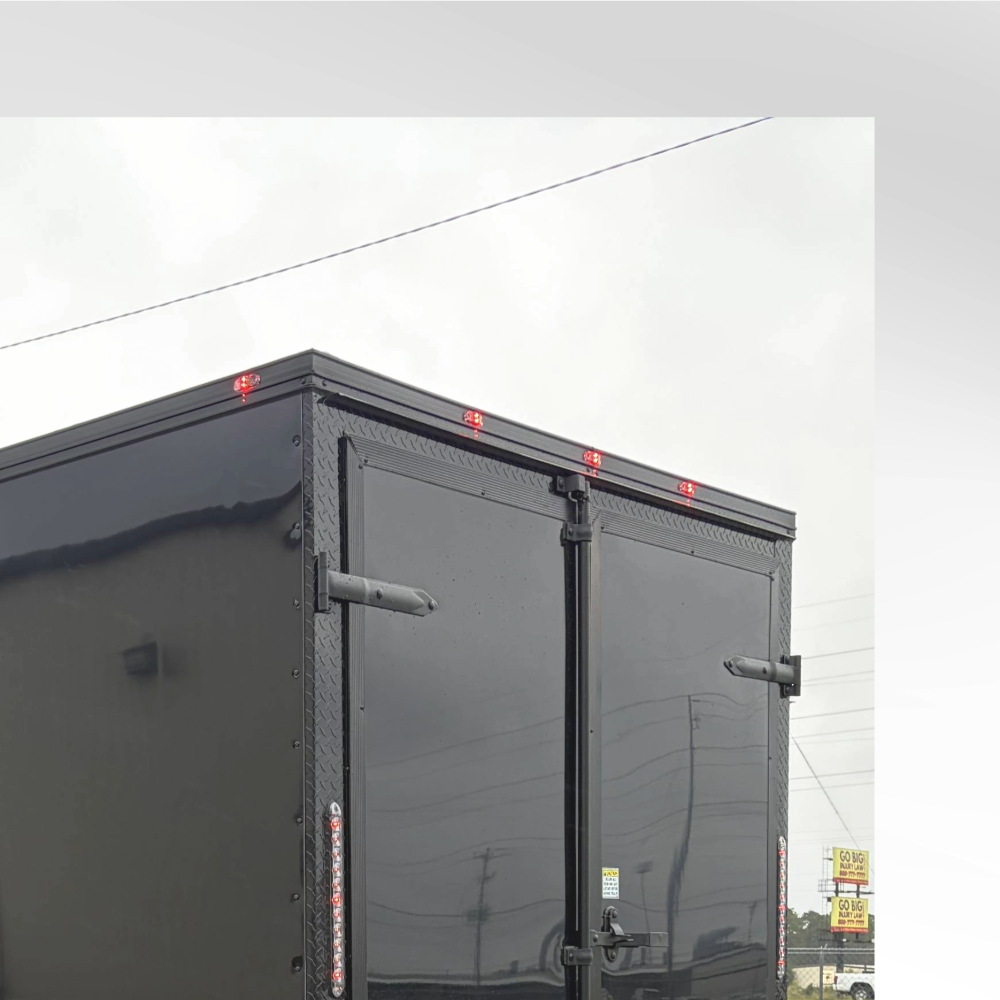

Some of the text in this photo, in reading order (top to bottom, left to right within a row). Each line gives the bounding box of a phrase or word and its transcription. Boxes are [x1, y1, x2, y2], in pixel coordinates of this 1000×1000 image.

[840, 851, 850, 862] GO
[852, 852, 864, 864] BIG
[839, 899, 849, 910] GO
[851, 900, 862, 911] BIG
